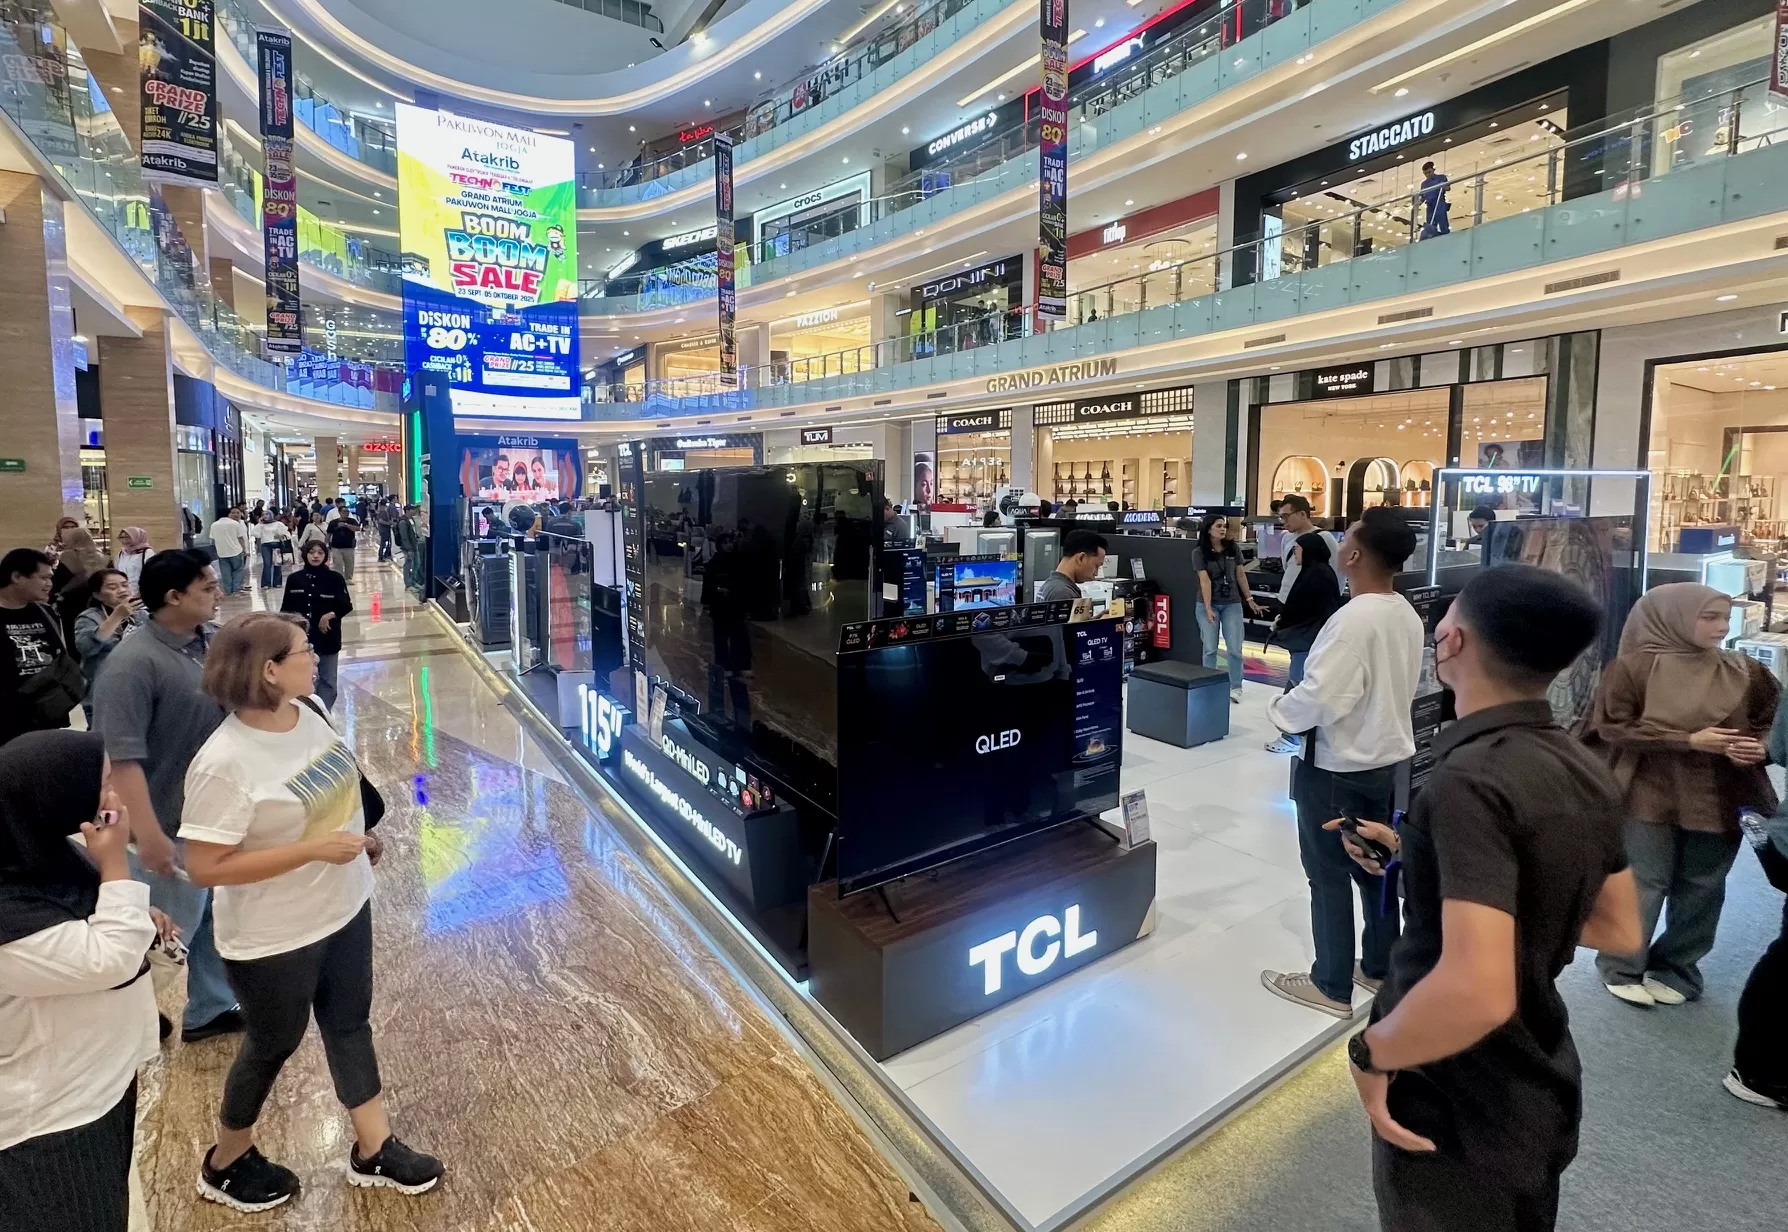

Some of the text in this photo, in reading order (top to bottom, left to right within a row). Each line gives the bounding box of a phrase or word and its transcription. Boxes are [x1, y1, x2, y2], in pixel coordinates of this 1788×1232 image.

[178, 7, 209, 22] BANK
[258, 34, 290, 46] Atakrib
[1043, 59, 1064, 71] SALE
[1045, 76, 1053, 86] 23
[145, 80, 207, 102] GRAND
[154, 92, 205, 114] PRIZE
[437, 115, 537, 148] PAKUWON MALL
[928, 117, 986, 155] CONVERSE
[1349, 112, 1434, 160] STACCATO
[496, 141, 528, 154] JOGJA
[142, 155, 187, 169] Atakrib
[461, 147, 520, 170] Atakrib
[1044, 156, 1063, 168] TRADE
[264, 188, 295, 201] DISKON
[461, 190, 522, 208] GRAND ATRIUM
[793, 192, 822, 209] crocs
[446, 196, 537, 219] PAKUWON MALL JOGJA
[269, 227, 294, 236] TRADE
[463, 212, 530, 240] BOOM
[277, 235, 295, 247] AC
[446, 230, 548, 273] BOOM
[1042, 264, 1063, 274] GRAND
[1046, 271, 1062, 279] PRIZE
[452, 262, 542, 295] SALE
[458, 287, 466, 295] 23
[494, 291, 519, 301] OKTOBER
[269, 312, 296, 320] GRAND
[529, 322, 559, 334] TRADE
[510, 333, 571, 354] AC+TV
[986, 358, 1117, 392] GRAND ATRIUM
[1318, 369, 1368, 385] kate spade
[1080, 401, 1132, 416] COACH
[952, 416, 992, 428] COACH
[498, 435, 538, 446] Atakrib
[618, 442, 632, 456] TCL
[1463, 475, 1494, 493] TCL
[1521, 475, 1539, 493] TV
[1124, 512, 1160, 522] MODENA
[1157, 598, 1167, 633] TCL
[1087, 638, 1101, 646] QLED
[975, 729, 1021, 754] QLED
[726, 836, 742, 866] TV
[969, 903, 1098, 996] TCL
